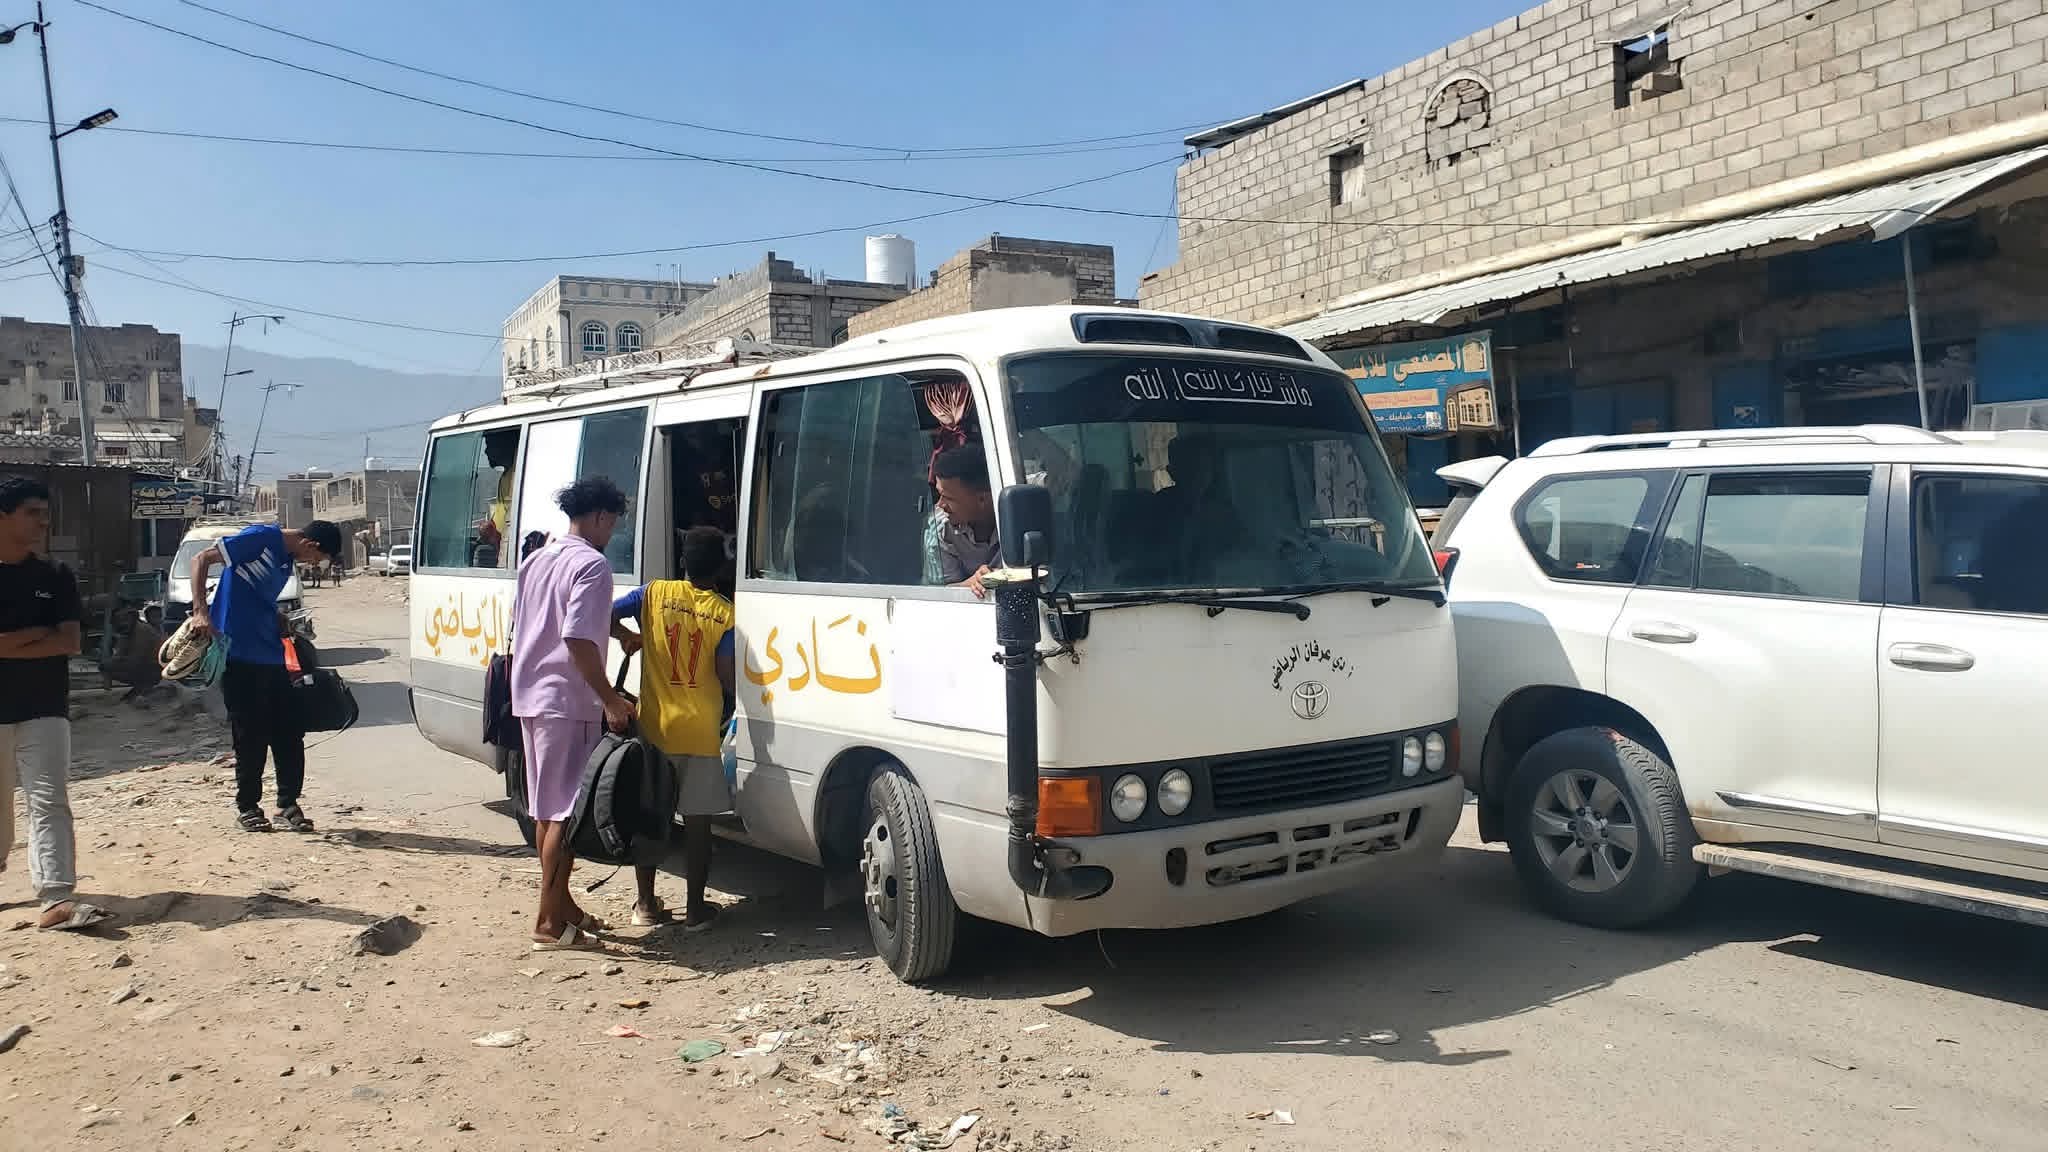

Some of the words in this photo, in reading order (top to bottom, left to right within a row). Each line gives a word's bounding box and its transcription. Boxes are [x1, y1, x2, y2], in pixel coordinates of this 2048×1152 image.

[1125, 367, 1169, 400] الله
[1184, 368, 1223, 391] الله
[1223, 371, 1273, 398] تبارك
[665, 622, 705, 689] 11
[1304, 639, 1331, 662] عرفان
[1271, 644, 1301, 691] الرياضي
